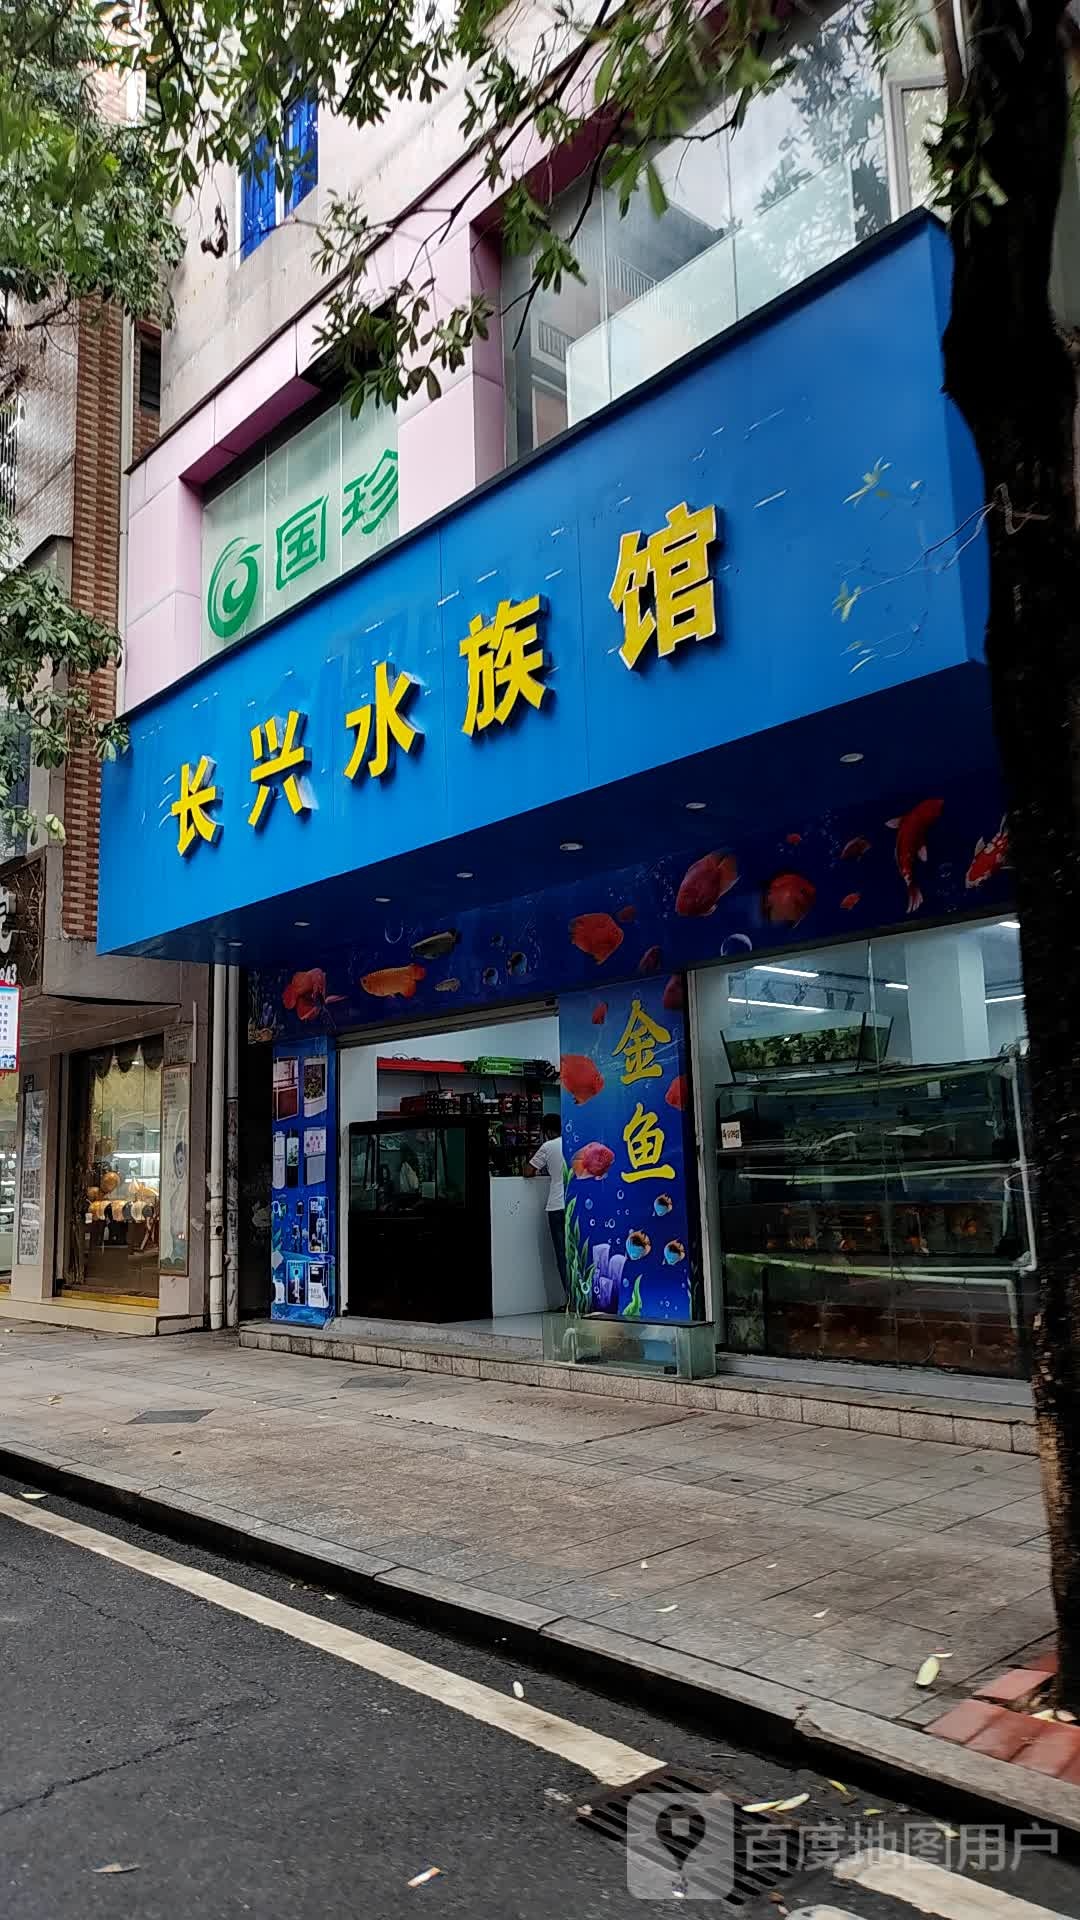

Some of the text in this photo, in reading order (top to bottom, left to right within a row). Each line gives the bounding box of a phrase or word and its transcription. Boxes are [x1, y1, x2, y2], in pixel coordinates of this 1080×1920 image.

[275, 448, 399, 591] 国珍
[170, 500, 718, 858] 长兴水族馆
[612, 999, 677, 1184] 金鱼
